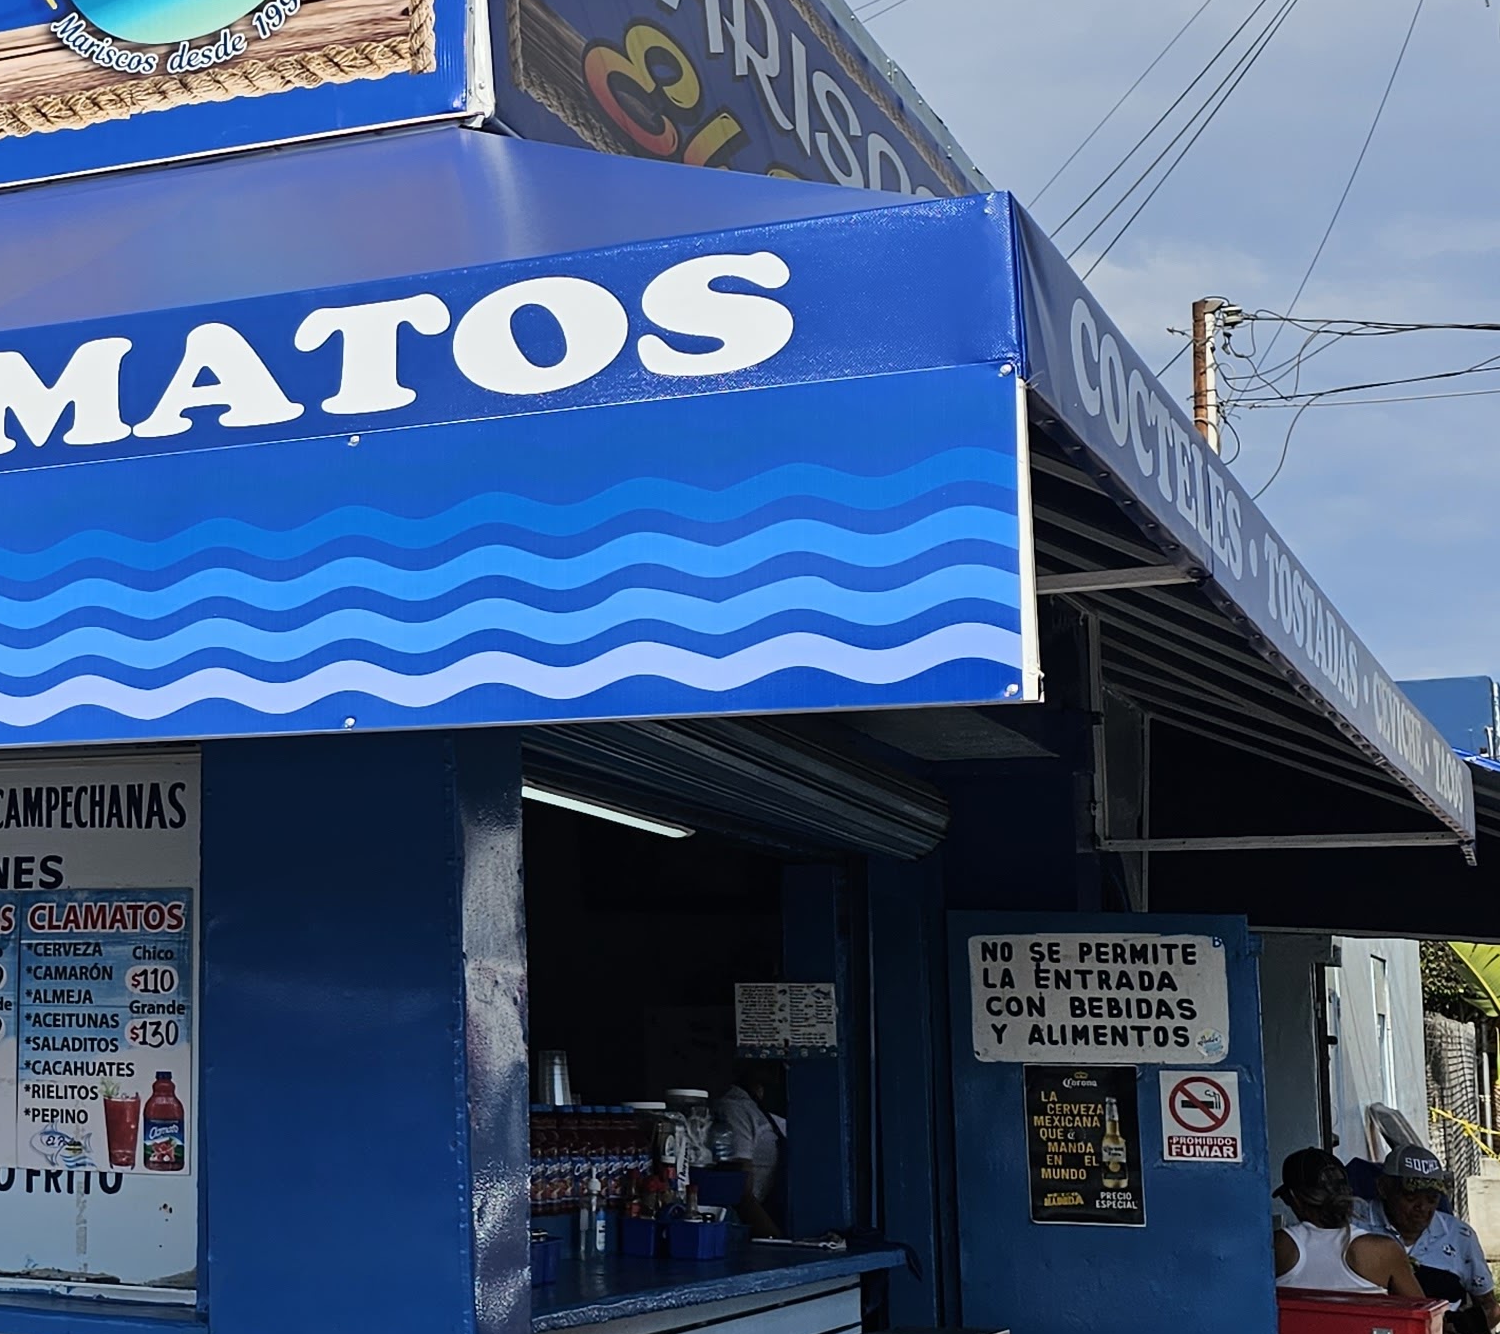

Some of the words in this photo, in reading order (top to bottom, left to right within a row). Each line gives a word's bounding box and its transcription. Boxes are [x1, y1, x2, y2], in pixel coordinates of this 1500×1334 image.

[51, 12, 158, 75] Mariscos
[167, 31, 248, 73] desde
[1070, 297, 1244, 582] COCTELES
[1263, 531, 1361, 711] TOSTADAS
[1373, 670, 1425, 776] CEVICHE
[1432, 737, 1464, 814] TACOS
[27, 901, 186, 933] CLAMATOS
[132, 944, 175, 961] Chico
[980, 941, 1013, 963] NO
[1029, 942, 1061, 964] SE
[1078, 942, 1198, 966] PERMITE
[131, 967, 175, 994] $110
[982, 968, 1015, 990] LA
[1034, 968, 1179, 992] ENTRADA
[128, 999, 186, 1015] Grande
[985, 995, 1046, 1018] CON
[1069, 996, 1198, 1020] BEBIDAS
[130, 1019, 180, 1048] $130
[990, 1023, 1008, 1045] Y
[1028, 1023, 1191, 1047] ALIMENTOS
[1062, 1077, 1098, 1090] Corona
[1041, 1091, 1058, 1102] LA
[1047, 1103, 1105, 1116] CERVEZA
[1033, 1115, 1101, 1128] MEXICANA
[1039, 1127, 1065, 1141] QUE
[1172, 1136, 1233, 1146] PROHIBIDO
[1047, 1141, 1095, 1154] MANDA
[1171, 1144, 1235, 1158] FUMAR
[1046, 1154, 1063, 1166] EN
[1084, 1155, 1100, 1167] EL
[1041, 1167, 1088, 1180] MUNDO
[1100, 1191, 1132, 1201] PRECIO
[1095, 1200, 1138, 1210] ESPECIAL
